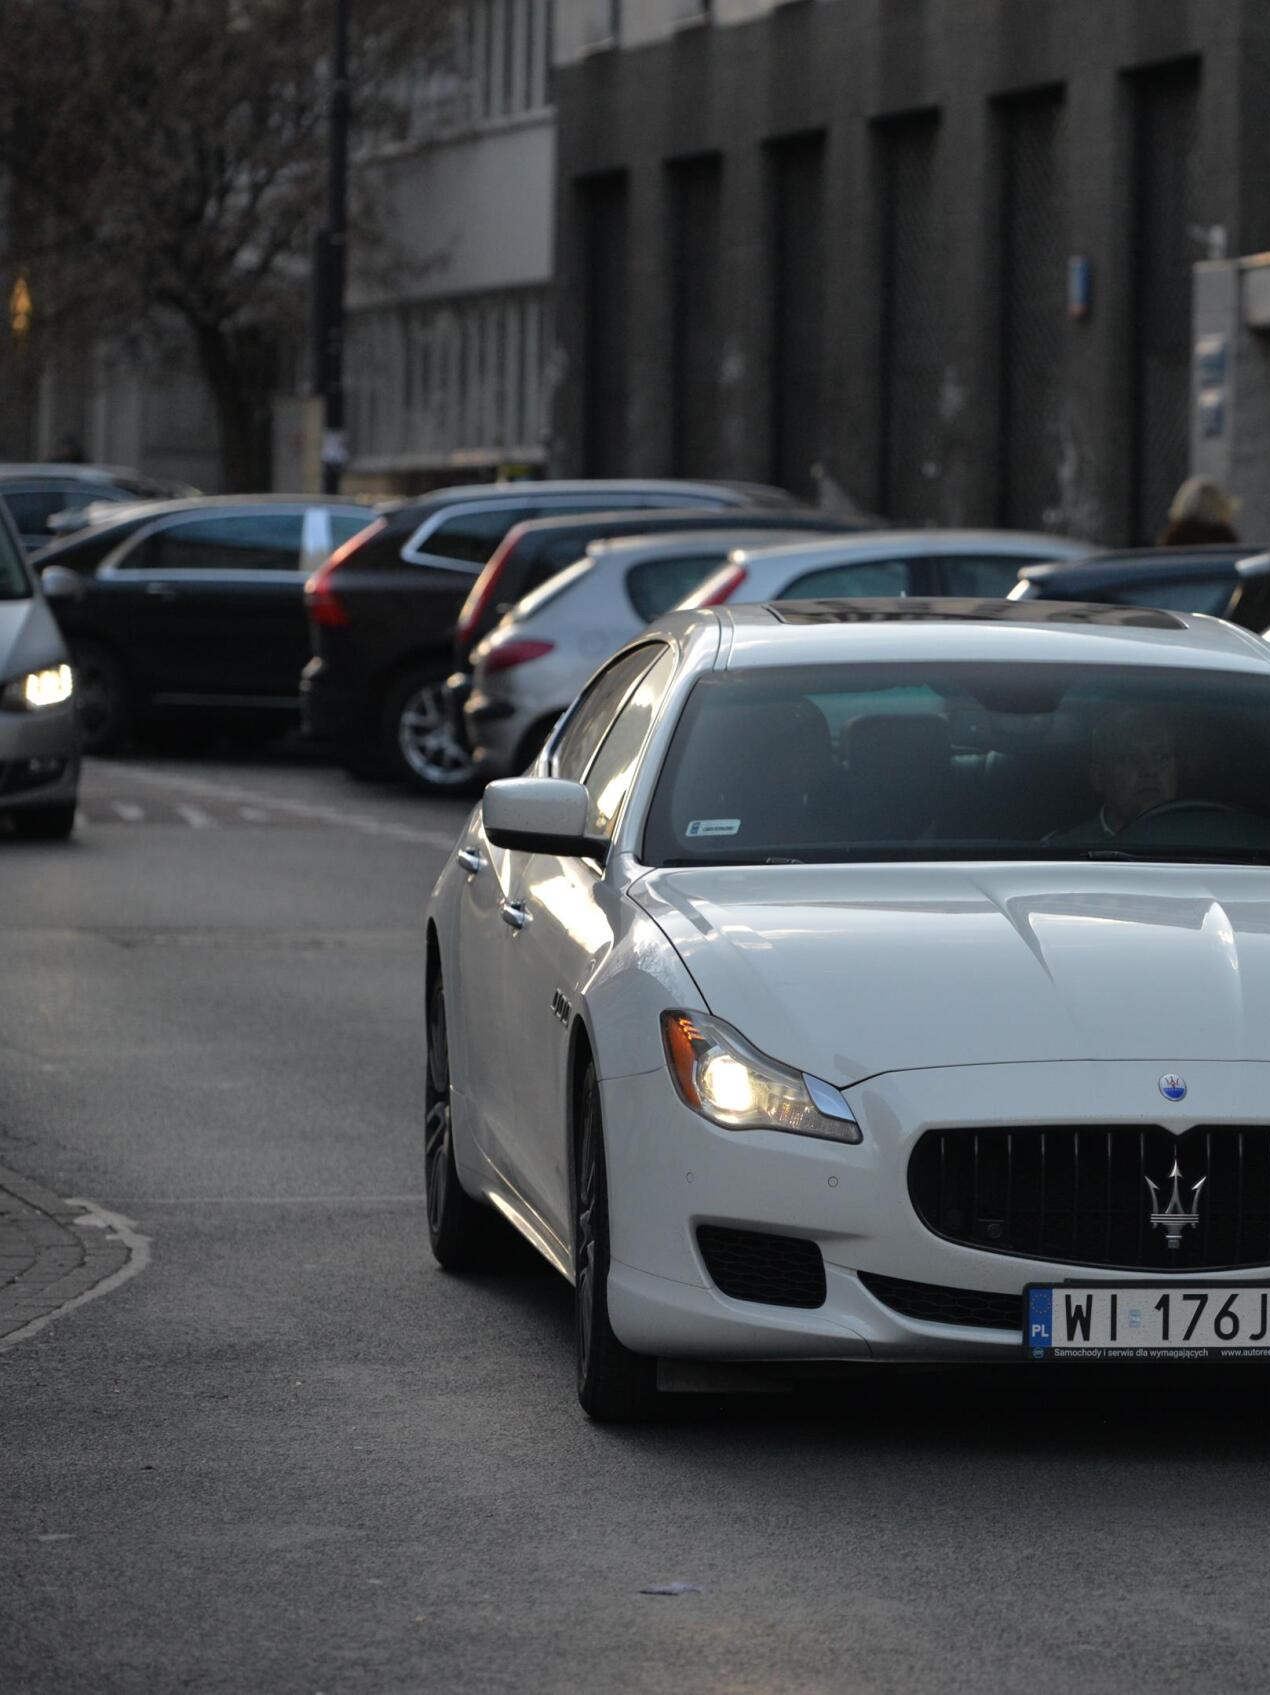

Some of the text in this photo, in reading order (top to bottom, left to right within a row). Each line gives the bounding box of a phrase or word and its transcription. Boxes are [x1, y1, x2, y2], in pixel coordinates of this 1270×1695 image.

[1065, 1294, 1117, 1341] WI
[1032, 1325, 1049, 1337] PL
[1054, 1348, 1101, 1358] Samochody
[1108, 1349, 1134, 1357] serwis
[1136, 1348, 1149, 1357] dla
[1150, 1348, 1209, 1358] wymagających
